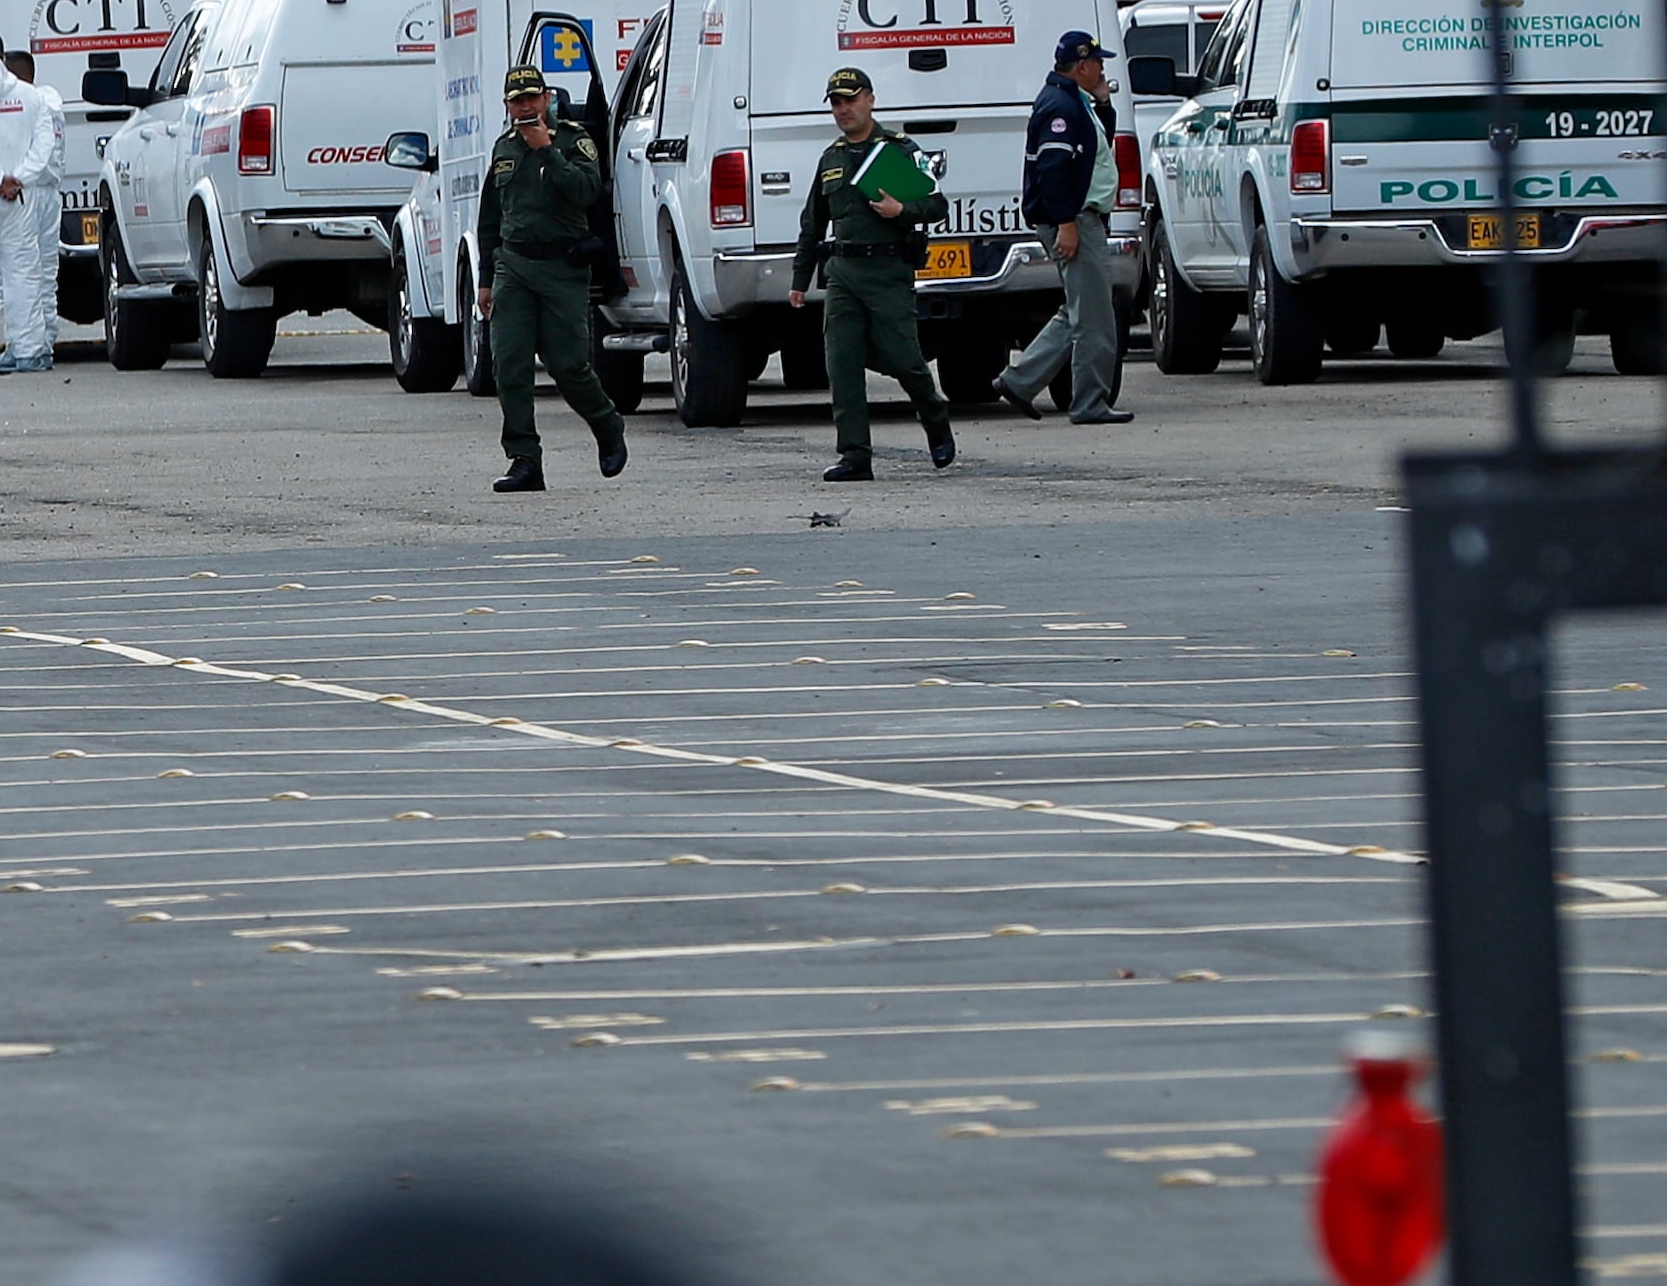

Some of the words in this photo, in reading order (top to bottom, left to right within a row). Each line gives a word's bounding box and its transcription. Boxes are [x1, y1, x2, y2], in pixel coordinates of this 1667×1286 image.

[1362, 15, 1465, 35] DIRECCIÓN
[1471, 17, 1493, 31] DE
[81, 39, 118, 47] GENERAL
[120, 37, 131, 46] DE
[132, 36, 142, 44] LA
[899, 33, 944, 43] GENERAL
[946, 33, 960, 42] DE
[961, 32, 974, 41] LA
[975, 30, 1011, 40] NACIÓN
[1402, 36, 1490, 51] CRIMINAL
[1514, 33, 1603, 48] INTERPOL
[1546, 112, 1574, 136] 19
[1596, 110, 1653, 135] 2027
